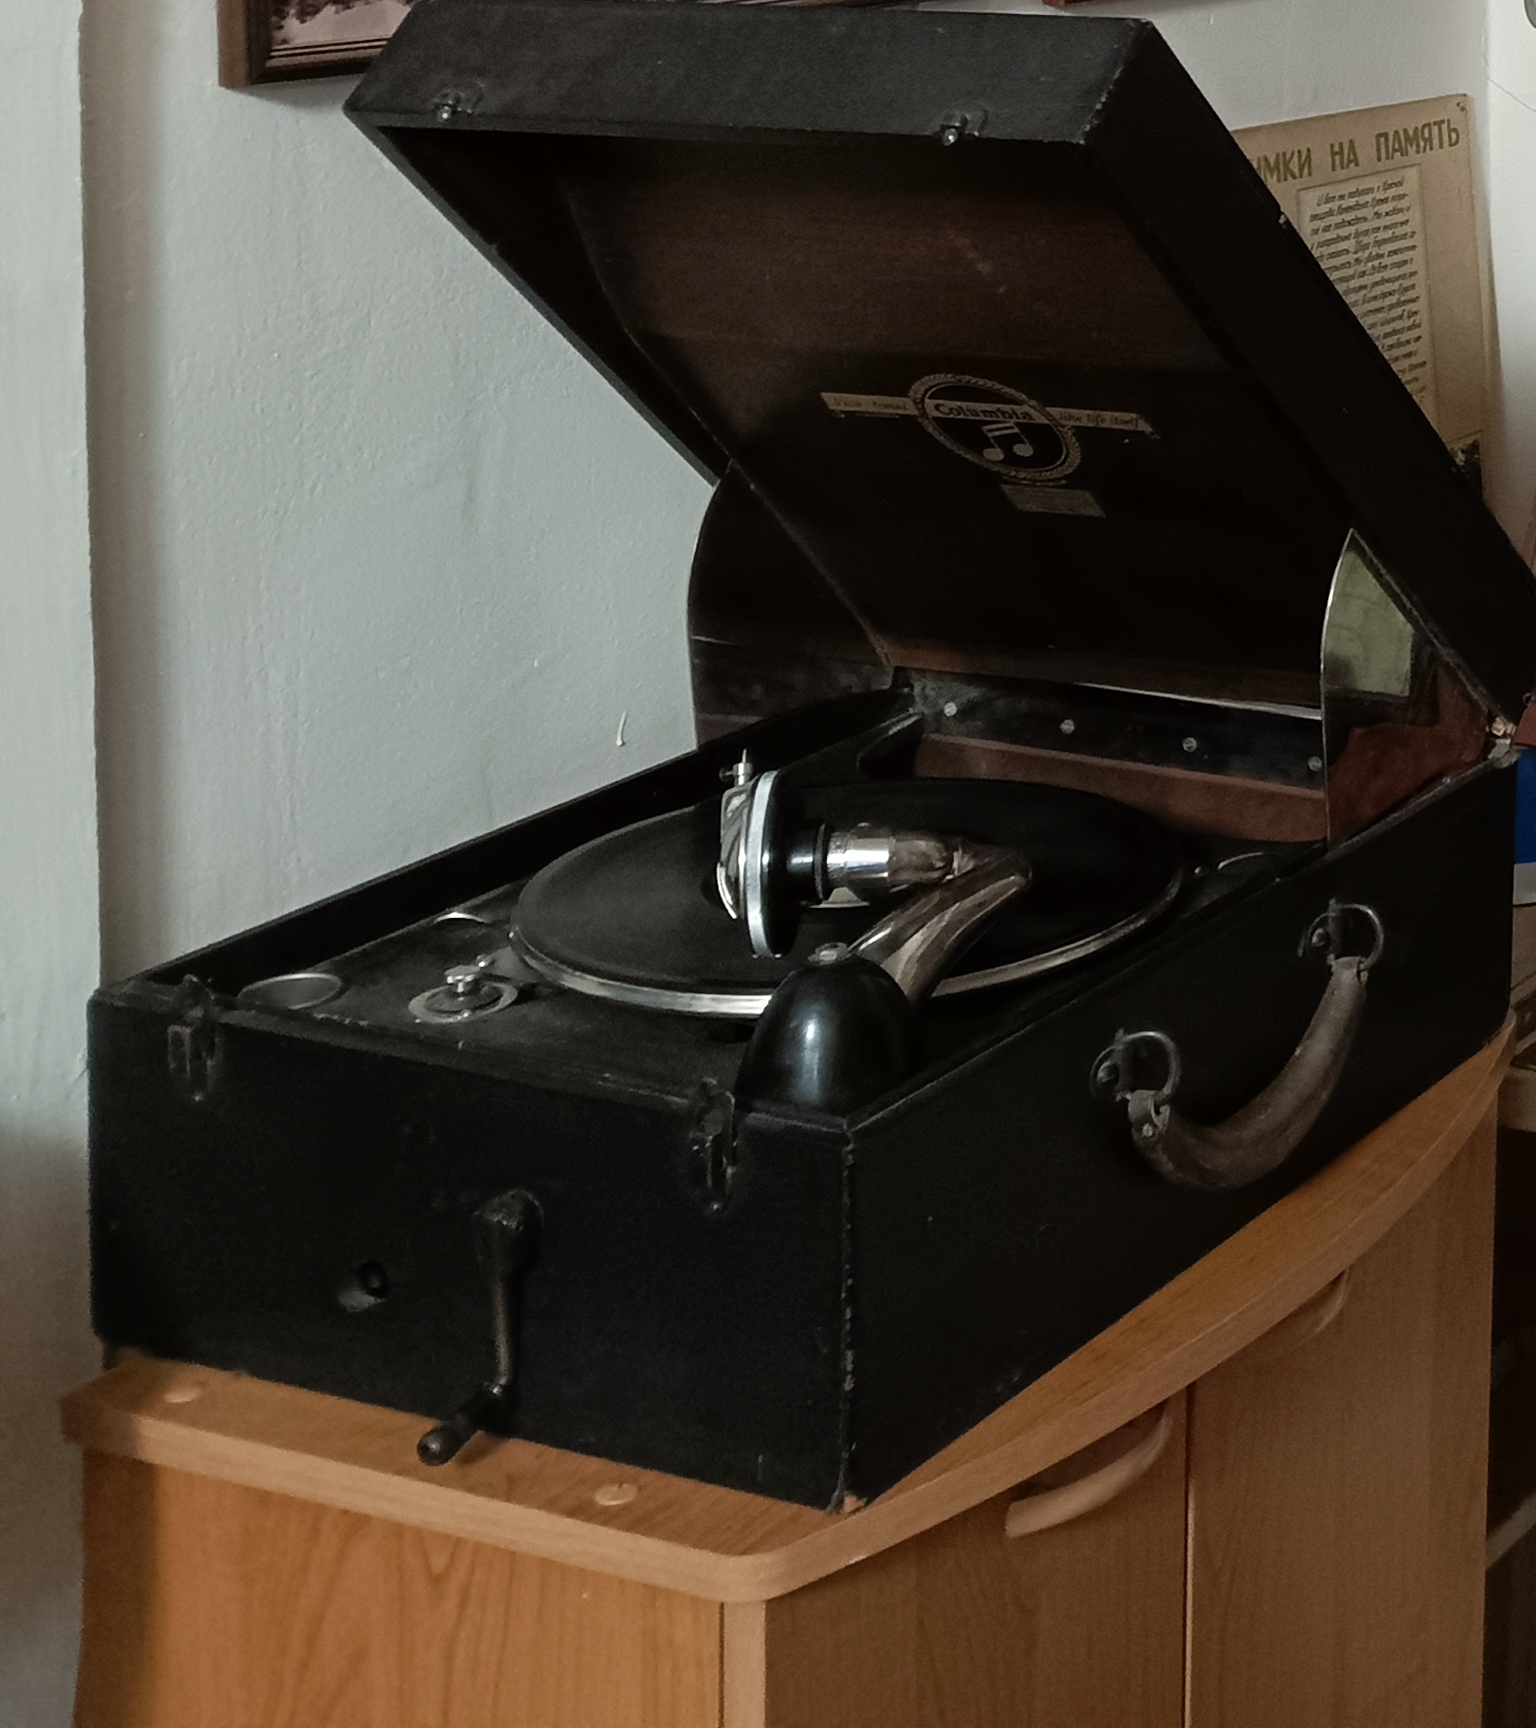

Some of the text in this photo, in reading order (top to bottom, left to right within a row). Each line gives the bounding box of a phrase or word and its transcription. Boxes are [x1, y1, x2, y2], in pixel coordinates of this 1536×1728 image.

[1330, 139, 1359, 172] НА
[1375, 118, 1460, 163] ПАМЯТЬ
[933, 402, 1037, 422] Columbia
